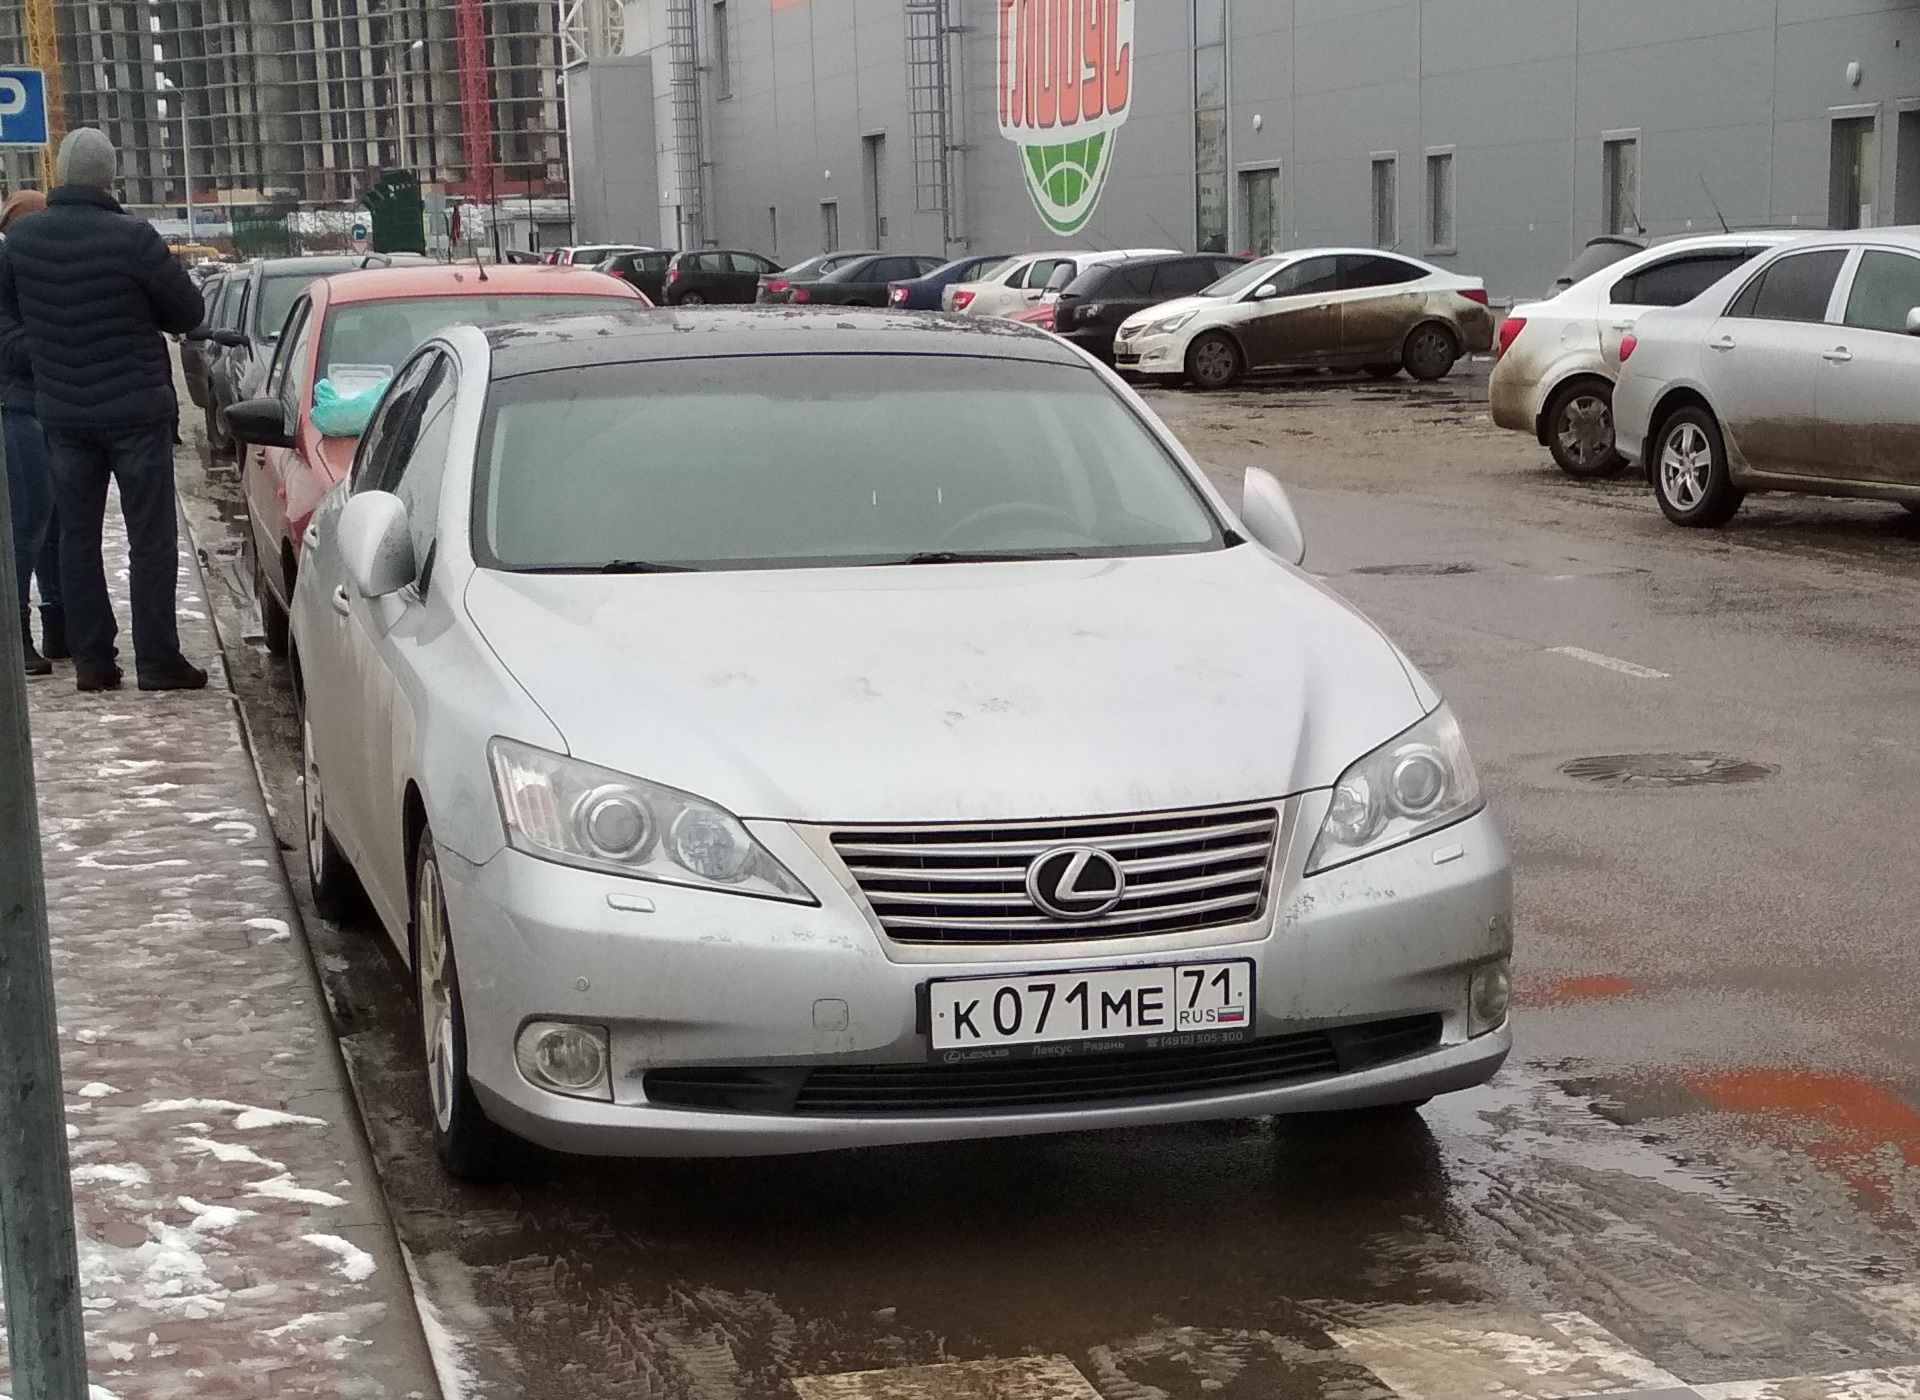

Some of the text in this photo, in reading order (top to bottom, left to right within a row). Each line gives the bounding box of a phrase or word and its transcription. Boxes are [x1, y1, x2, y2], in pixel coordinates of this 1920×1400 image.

[954, 968, 1231, 1040] К071МЕ 71
[1179, 1009, 1216, 1025] RUS
[1031, 1040, 1125, 1057] Лексус Рязань
